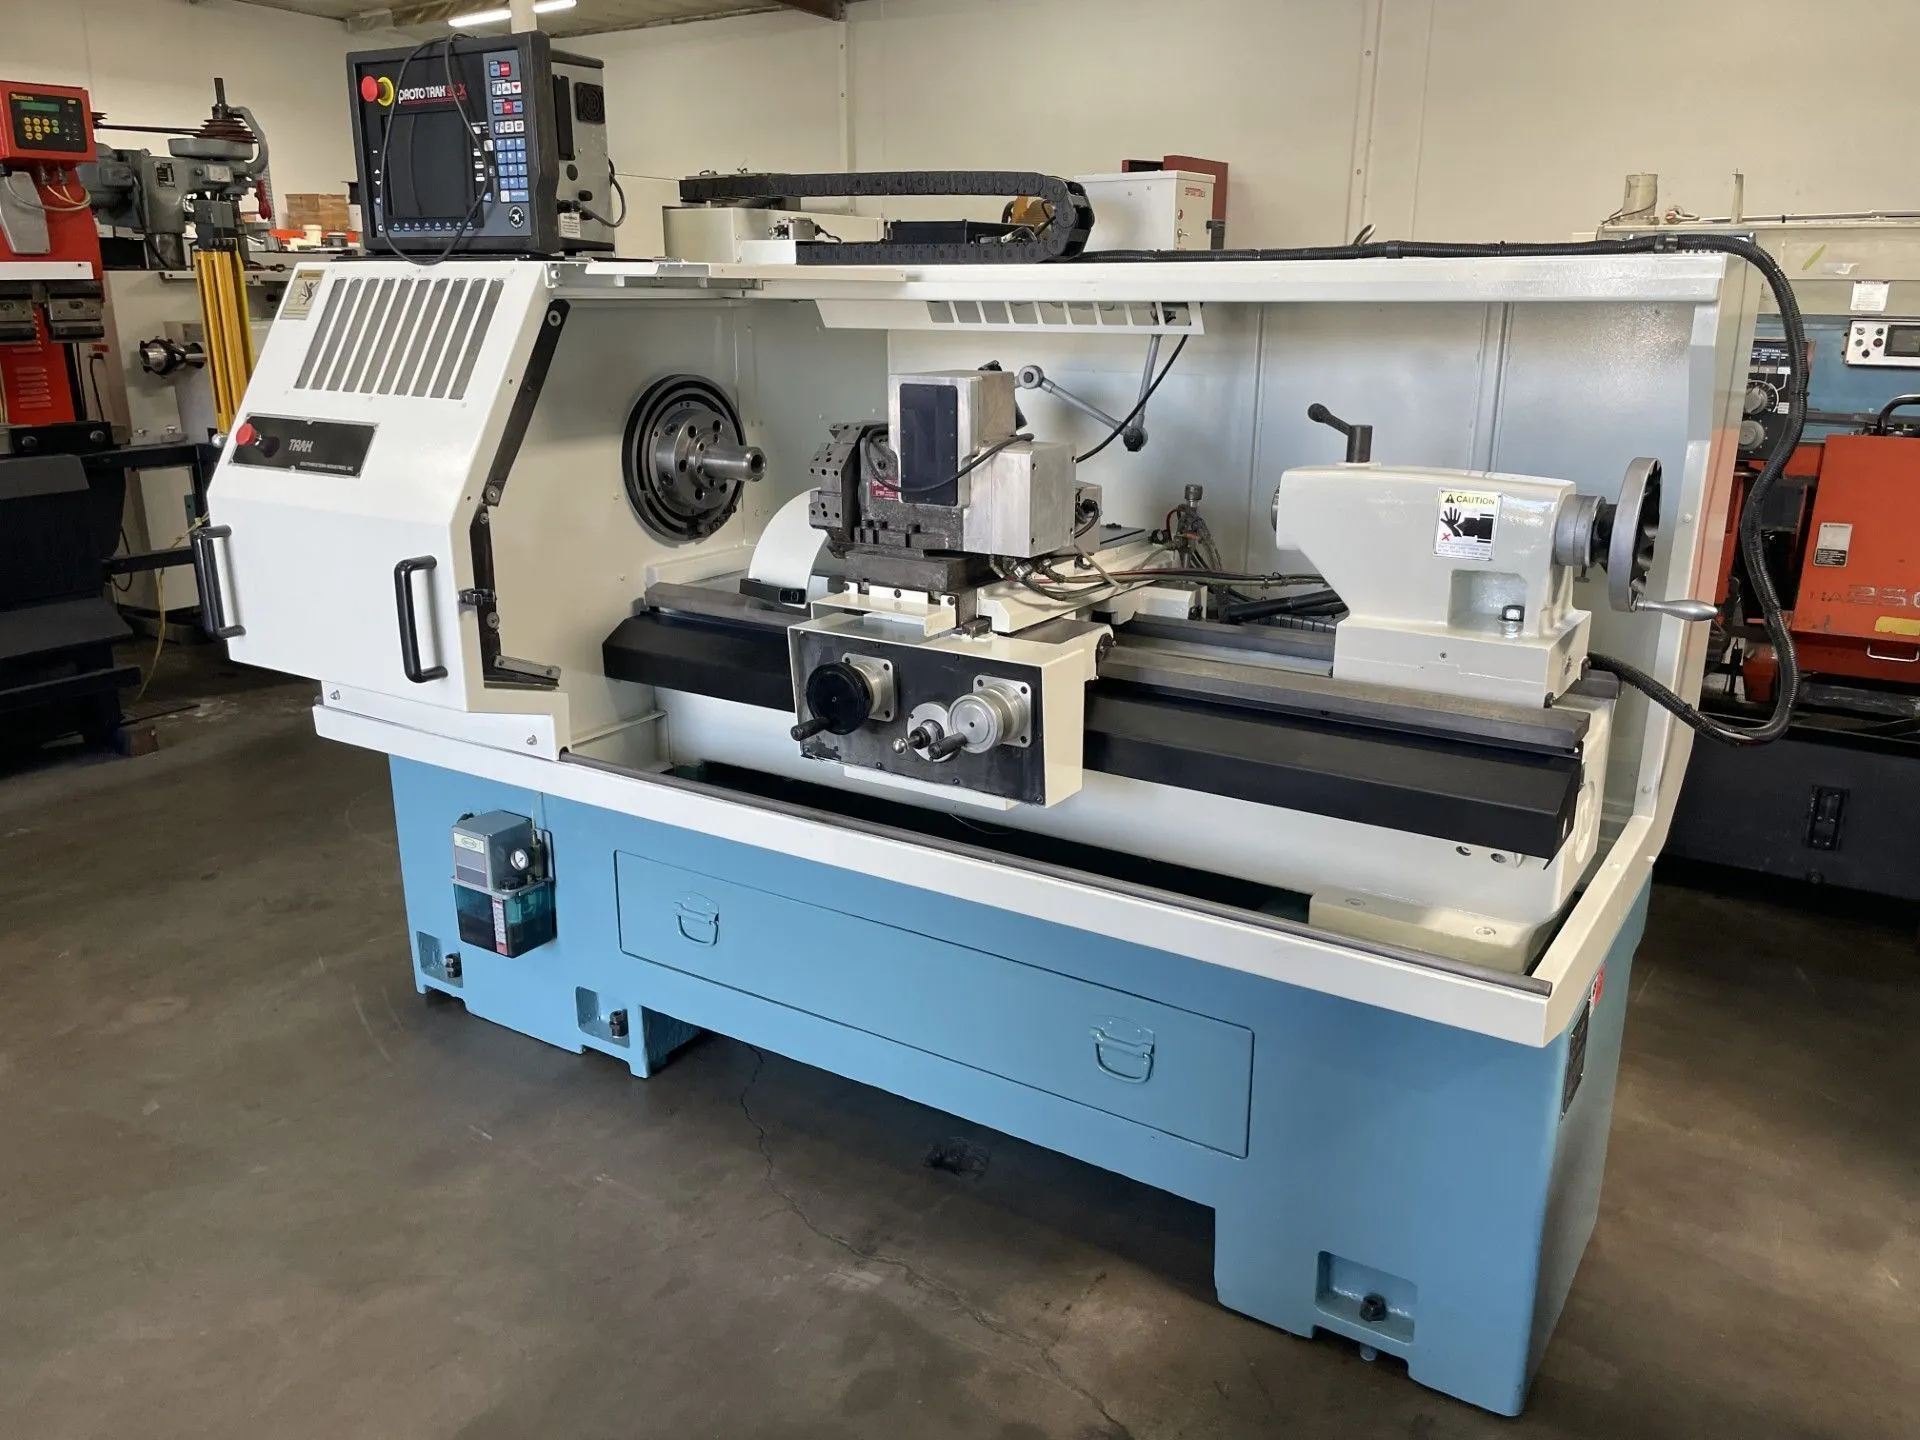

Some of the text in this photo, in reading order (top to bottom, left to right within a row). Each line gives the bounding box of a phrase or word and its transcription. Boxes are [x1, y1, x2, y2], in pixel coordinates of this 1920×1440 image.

[398, 87, 425, 104] PROTO
[425, 85, 446, 98] TRAK
[1456, 495, 1495, 505] CAUTION
